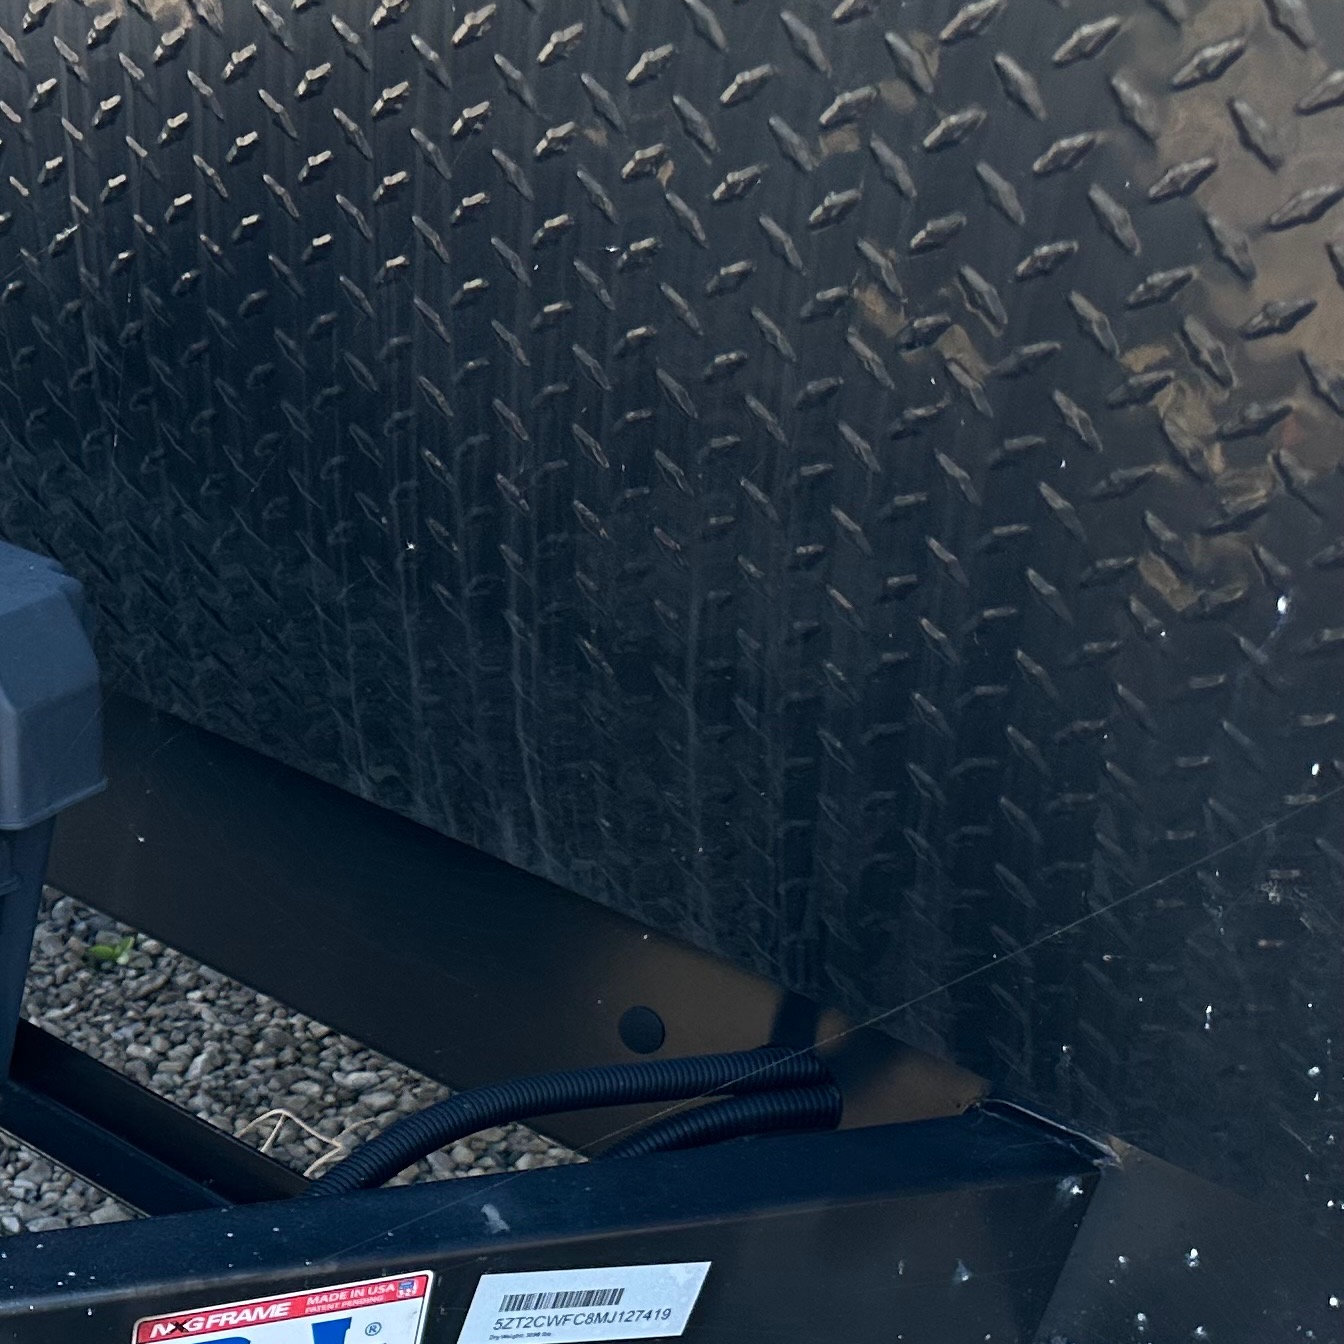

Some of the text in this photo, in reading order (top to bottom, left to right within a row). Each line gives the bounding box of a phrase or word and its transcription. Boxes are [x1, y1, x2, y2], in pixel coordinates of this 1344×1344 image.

[304, 1295, 385, 1315] PATENT PENDING
[306, 1283, 395, 1306] MADE IN USA
[204, 1302, 291, 1330] FRAME
[493, 1308, 672, 1331] 5ZT2CWFC8MJ127419
